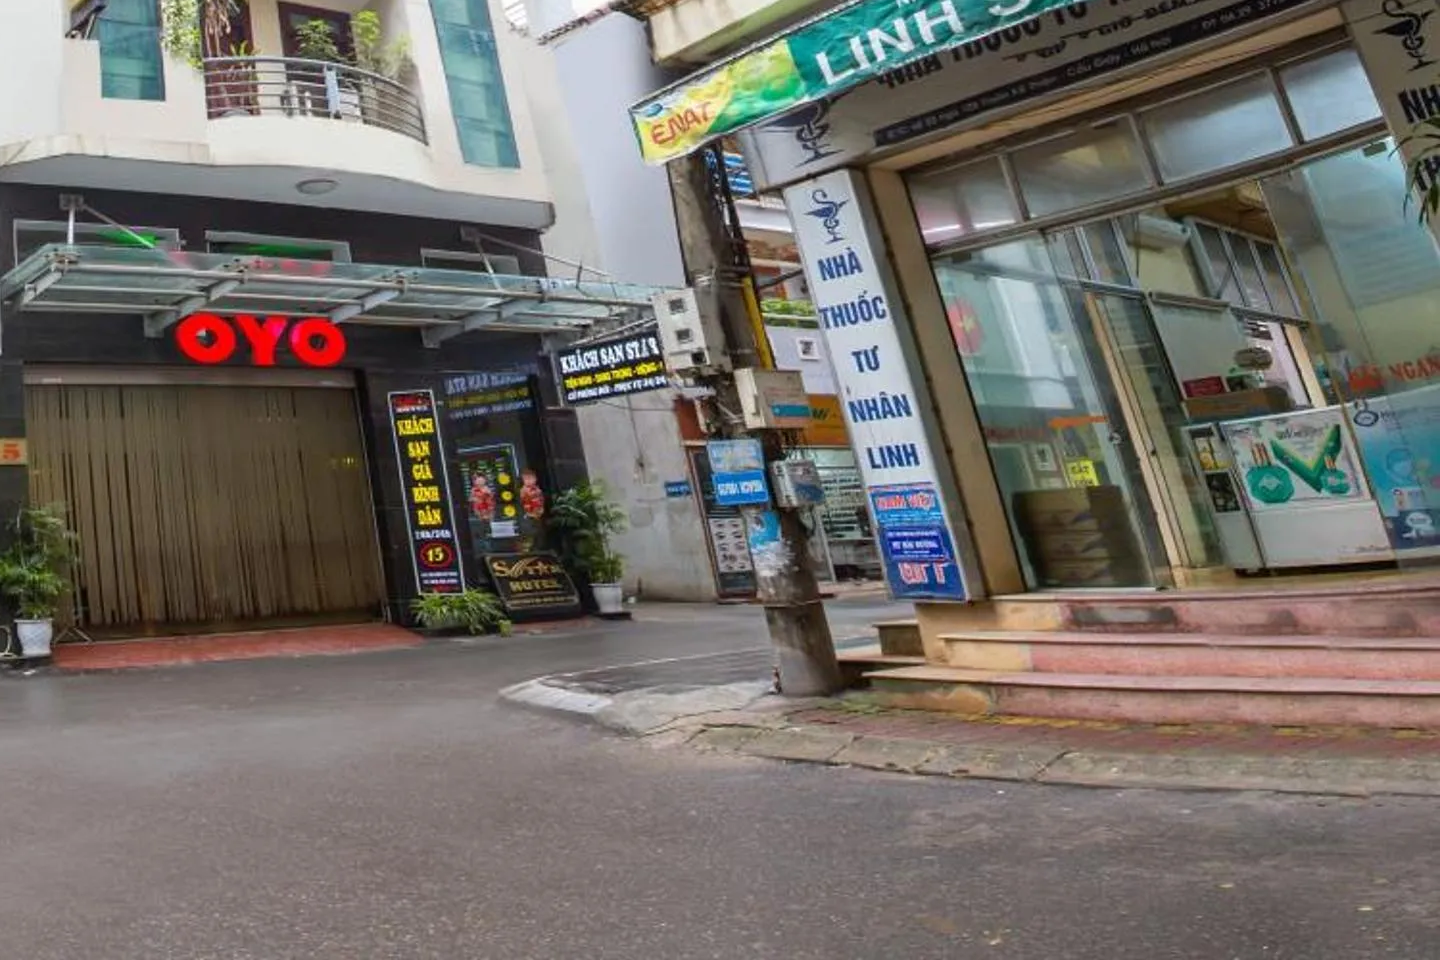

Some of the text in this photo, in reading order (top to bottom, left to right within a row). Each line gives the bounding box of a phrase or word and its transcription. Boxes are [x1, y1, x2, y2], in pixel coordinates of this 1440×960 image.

[651, 102, 712, 146] ENAT
[817, 247, 863, 282] NHÀ
[819, 289, 888, 330] THUỐC
[175, 310, 348, 368] OYO
[559, 348, 600, 374] KHÁCH
[599, 344, 625, 369] SẠN
[851, 344, 881, 374] TƯ
[848, 390, 913, 424] NHÂN
[397, 414, 435, 436] KHÁCH
[407, 440, 431, 462] SẠN
[867, 443, 921, 470] LINH
[412, 460, 434, 481] GIÁ
[427, 546, 445, 562] 15
